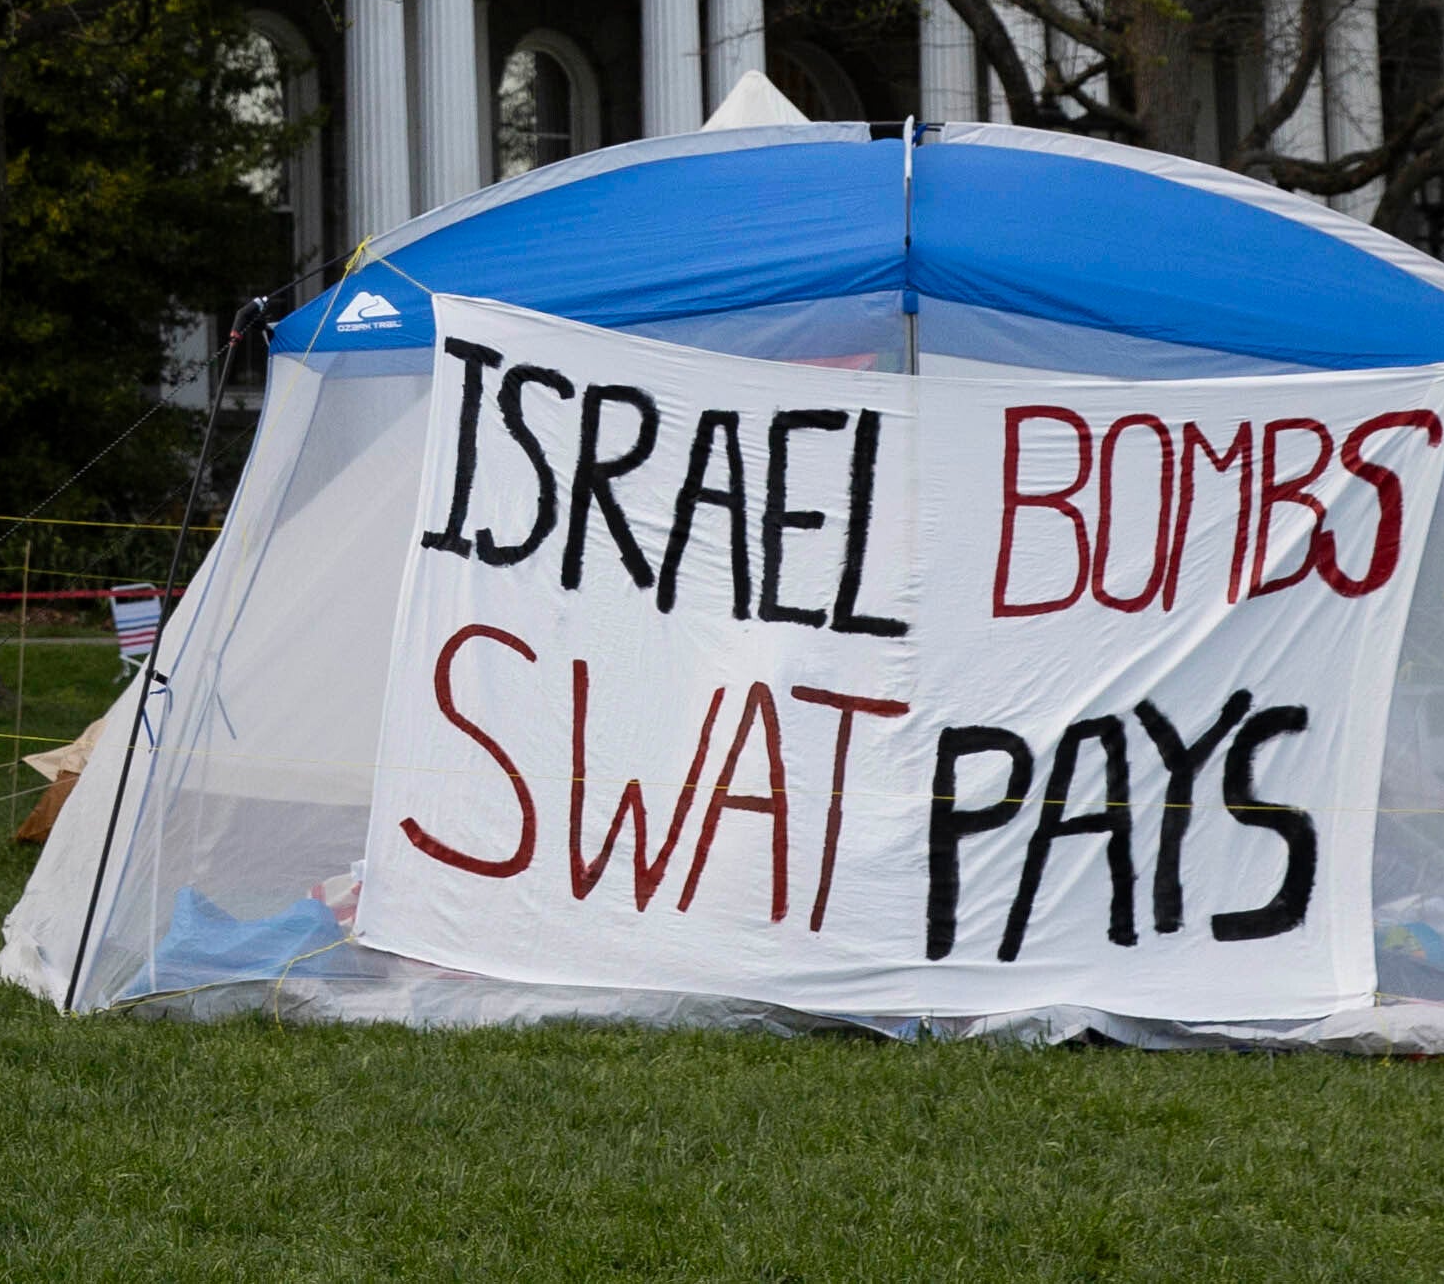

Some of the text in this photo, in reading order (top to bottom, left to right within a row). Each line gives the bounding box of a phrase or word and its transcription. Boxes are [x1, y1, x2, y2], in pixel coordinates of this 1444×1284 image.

[419, 336, 1444, 637] ISRAEL BOMBS
[399, 623, 1318, 962] SWAT PAYS
